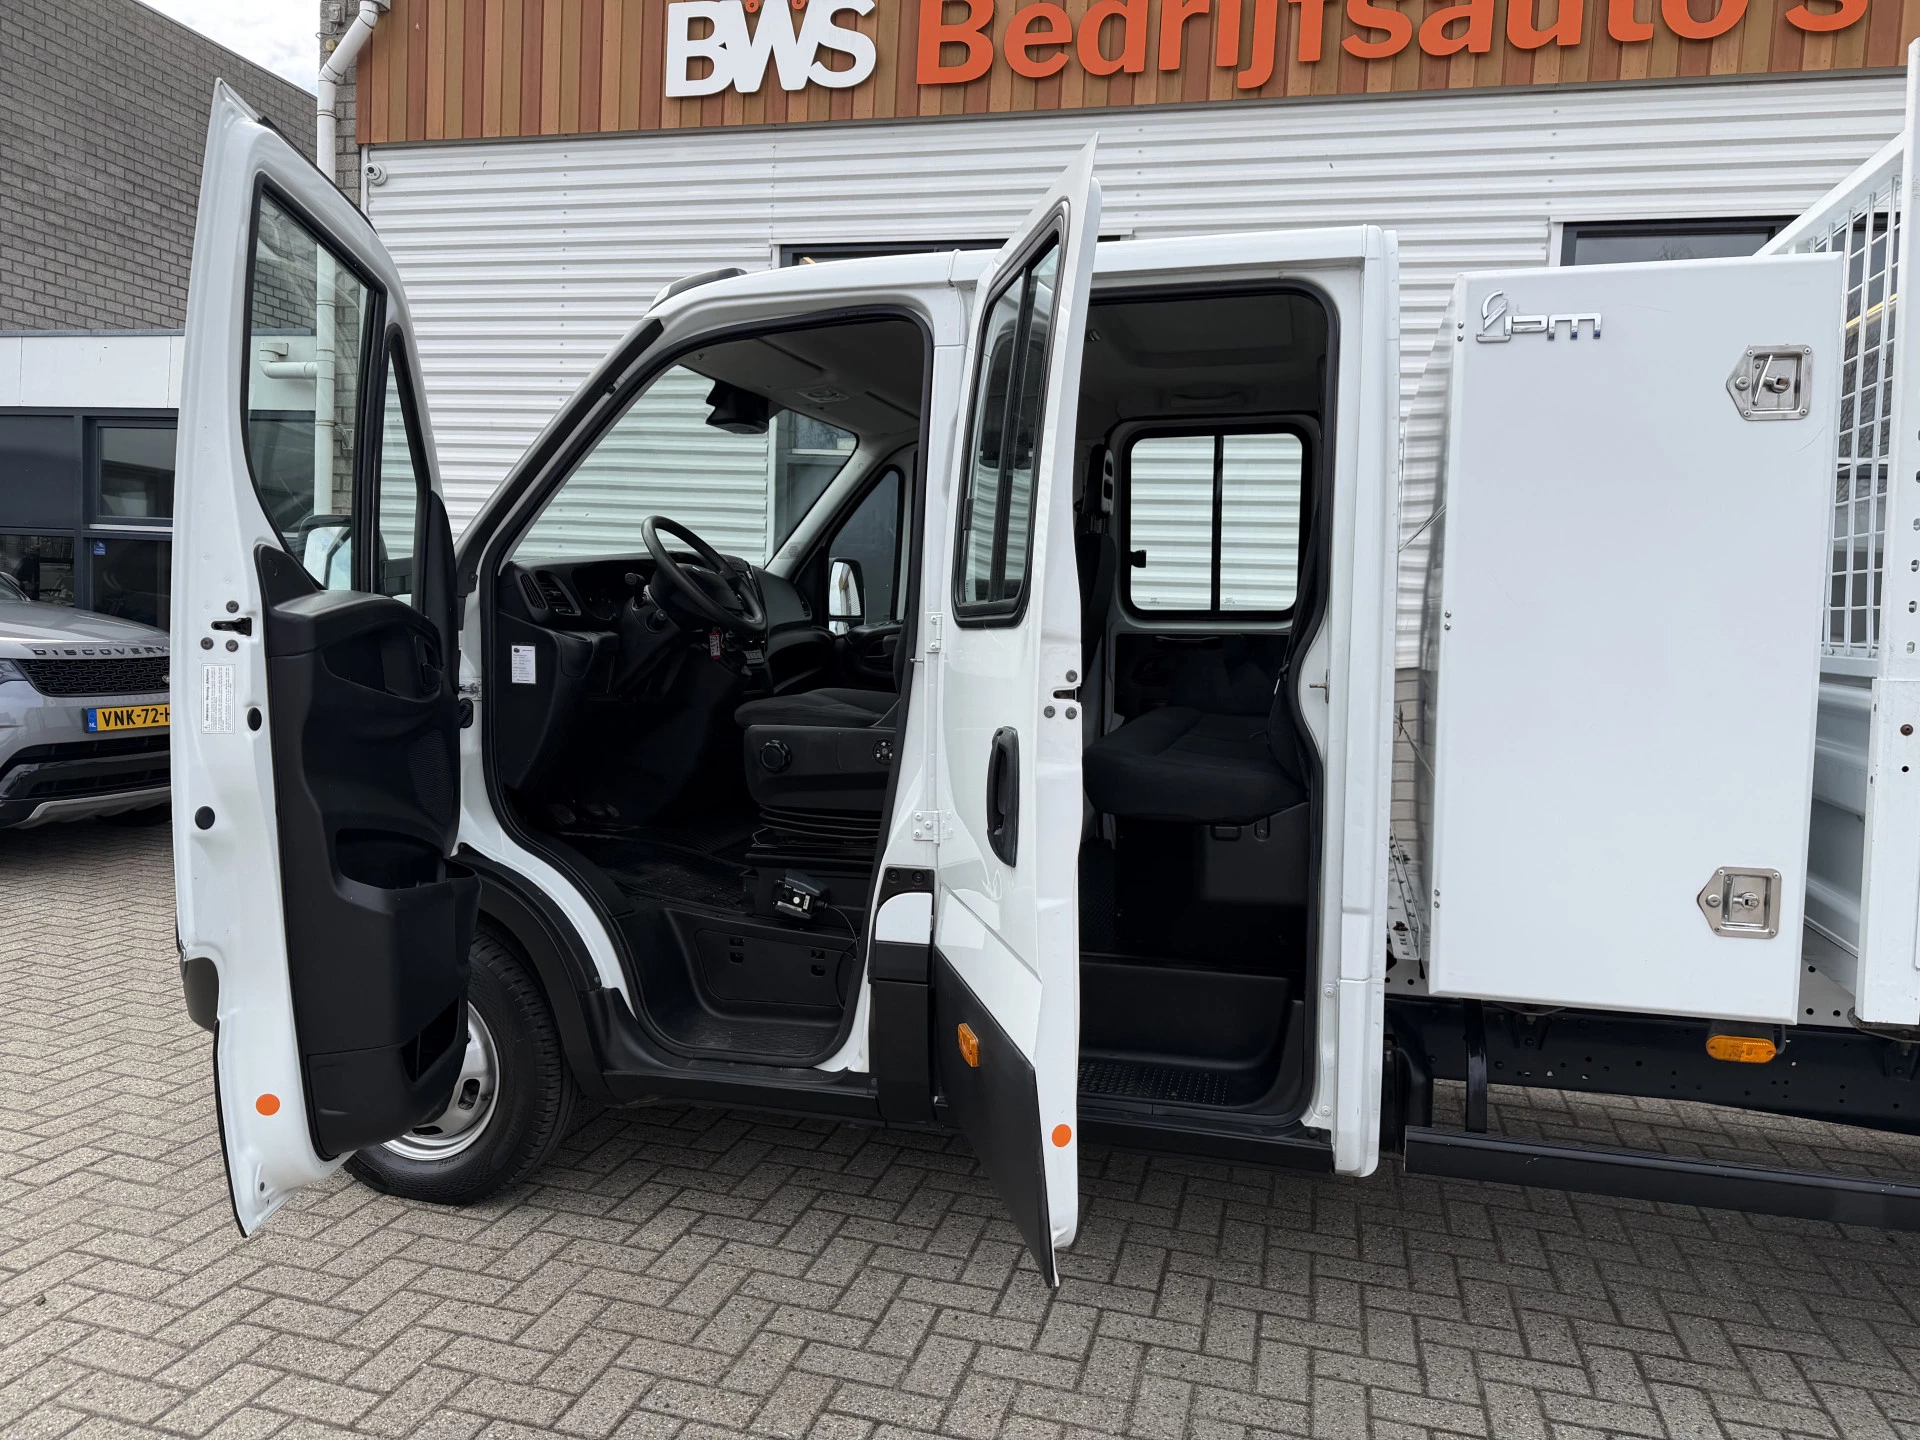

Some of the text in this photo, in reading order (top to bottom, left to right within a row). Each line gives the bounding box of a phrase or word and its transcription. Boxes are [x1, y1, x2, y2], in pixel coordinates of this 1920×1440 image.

[665, 0, 1868, 98] BWS Bedrijfsauo
[32, 646, 167, 656] DISCOVERY
